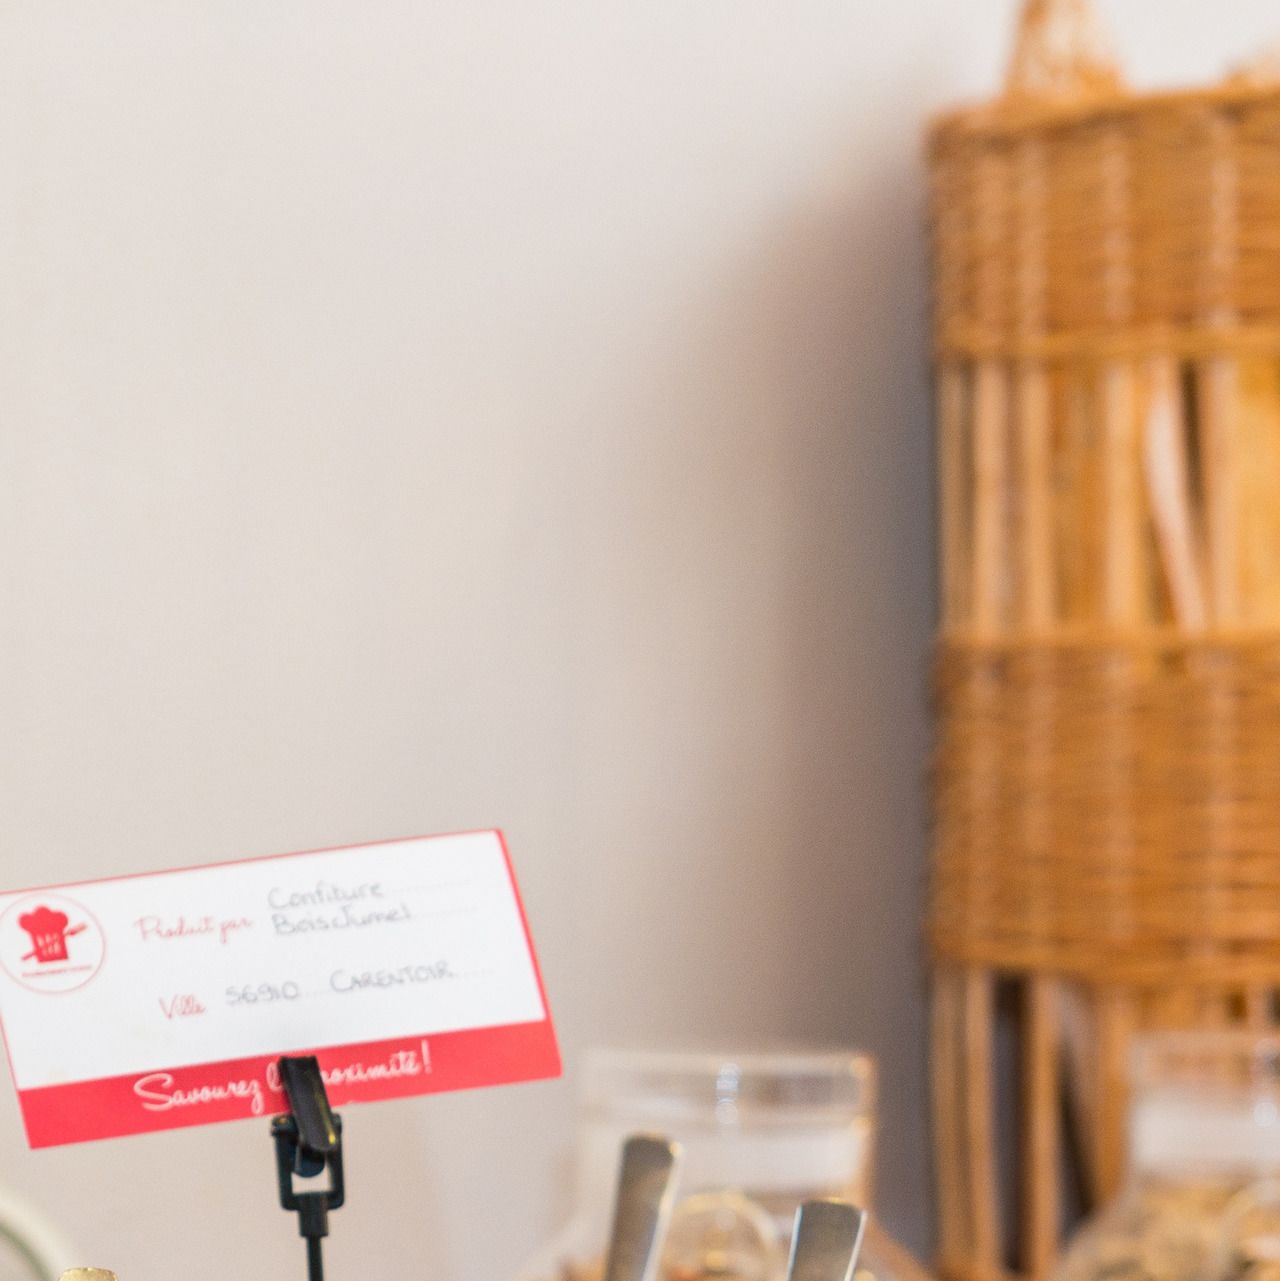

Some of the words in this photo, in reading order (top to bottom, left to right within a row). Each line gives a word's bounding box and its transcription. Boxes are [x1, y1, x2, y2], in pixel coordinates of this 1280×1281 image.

[267, 880, 384, 909] Confiture
[134, 915, 215, 940] Produit
[220, 917, 253, 944] par
[226, 982, 301, 1006] 56910
[329, 960, 454, 994] CARENTOIR
[160, 995, 206, 1019] Ville
[133, 1072, 266, 1115] Savourez
